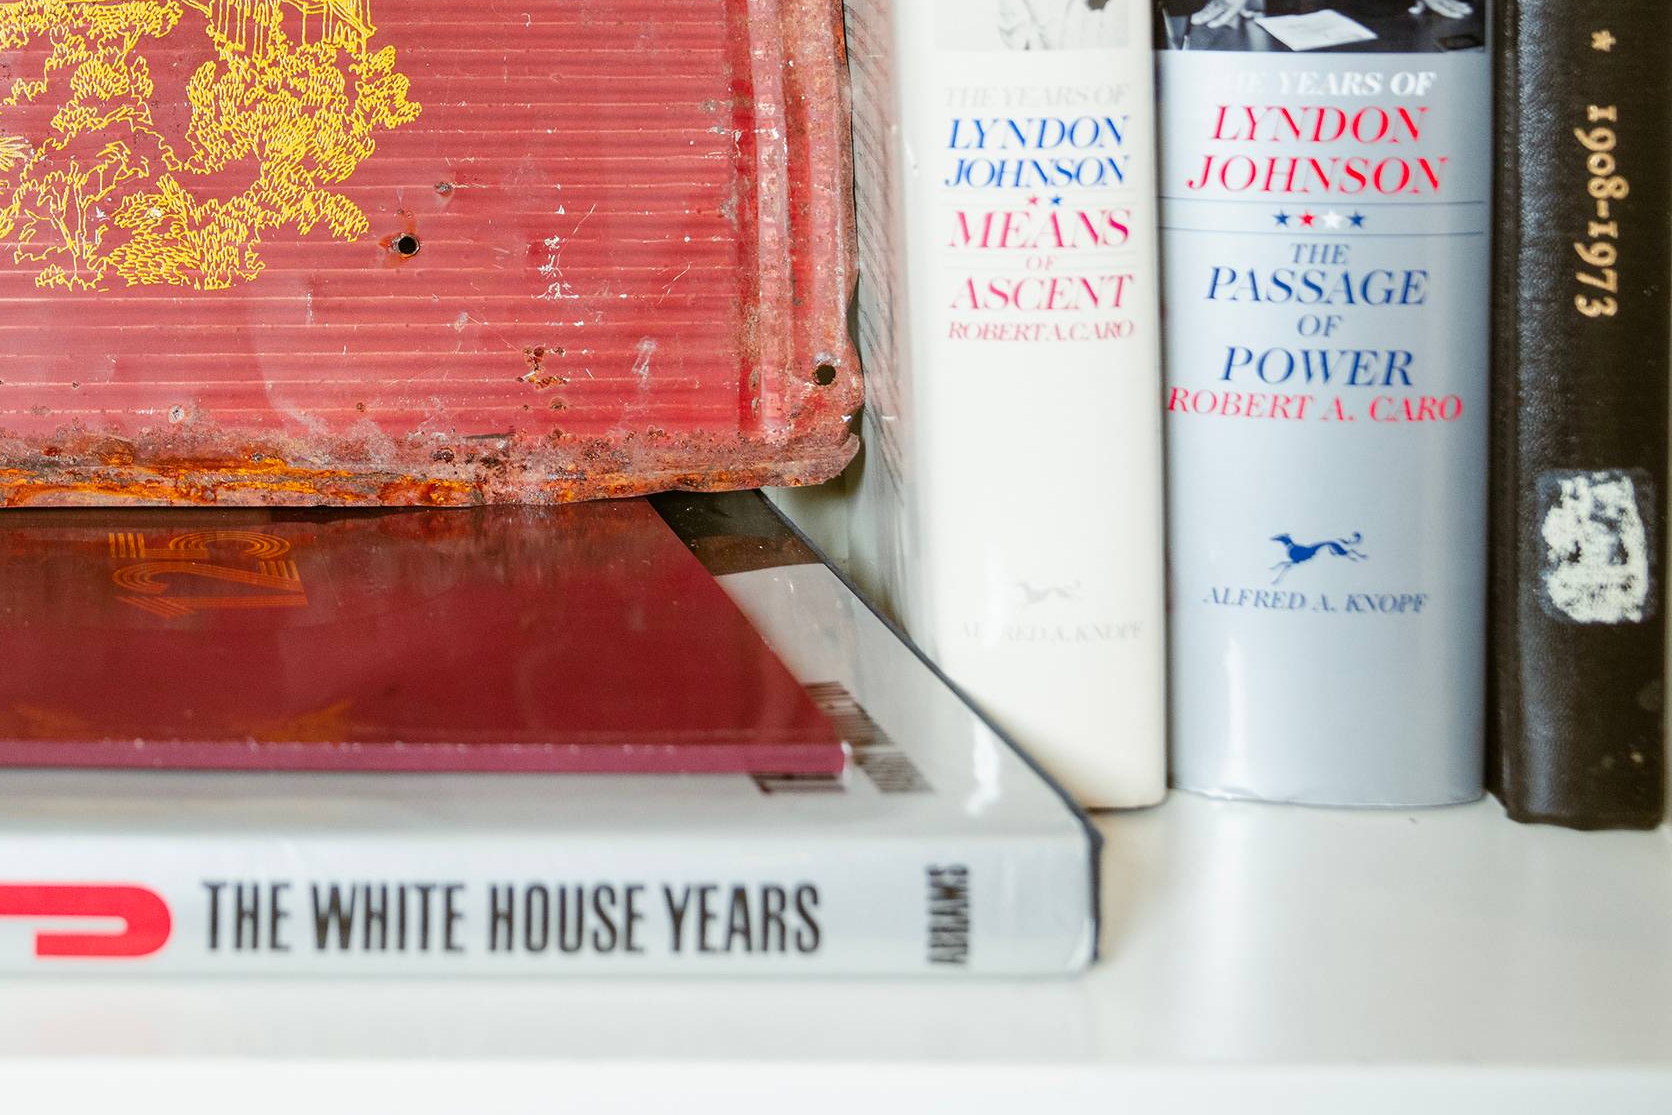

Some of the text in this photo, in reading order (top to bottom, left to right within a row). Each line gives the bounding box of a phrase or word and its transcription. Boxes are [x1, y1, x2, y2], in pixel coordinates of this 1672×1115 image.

[1277, 70, 1382, 97] YEARS
[1390, 70, 1437, 97] OF
[946, 115, 1130, 150] LYNDON
[1209, 103, 1430, 145] LYNDON
[944, 155, 1131, 189] JOHNSON
[1185, 153, 1449, 194] JOHNSON
[946, 208, 1132, 250] MEANS
[1024, 253, 1057, 271] OF
[1289, 242, 1351, 266] THE
[948, 273, 1134, 311] ASCENT
[1204, 265, 1429, 307] PASSAGE
[947, 319, 1041, 343] ROBERT
[1066, 318, 1135, 343] CARO
[1296, 313, 1345, 338] OF
[1217, 345, 1415, 388] POWER
[1167, 385, 1464, 423] ROBERT A. CARO
[1202, 586, 1429, 614] ALFRED A. KNOPF
[201, 878, 293, 954] THE
[310, 879, 466, 955] WHITE
[488, 880, 647, 956] HOUSE
[662, 880, 823, 957] YEARS
